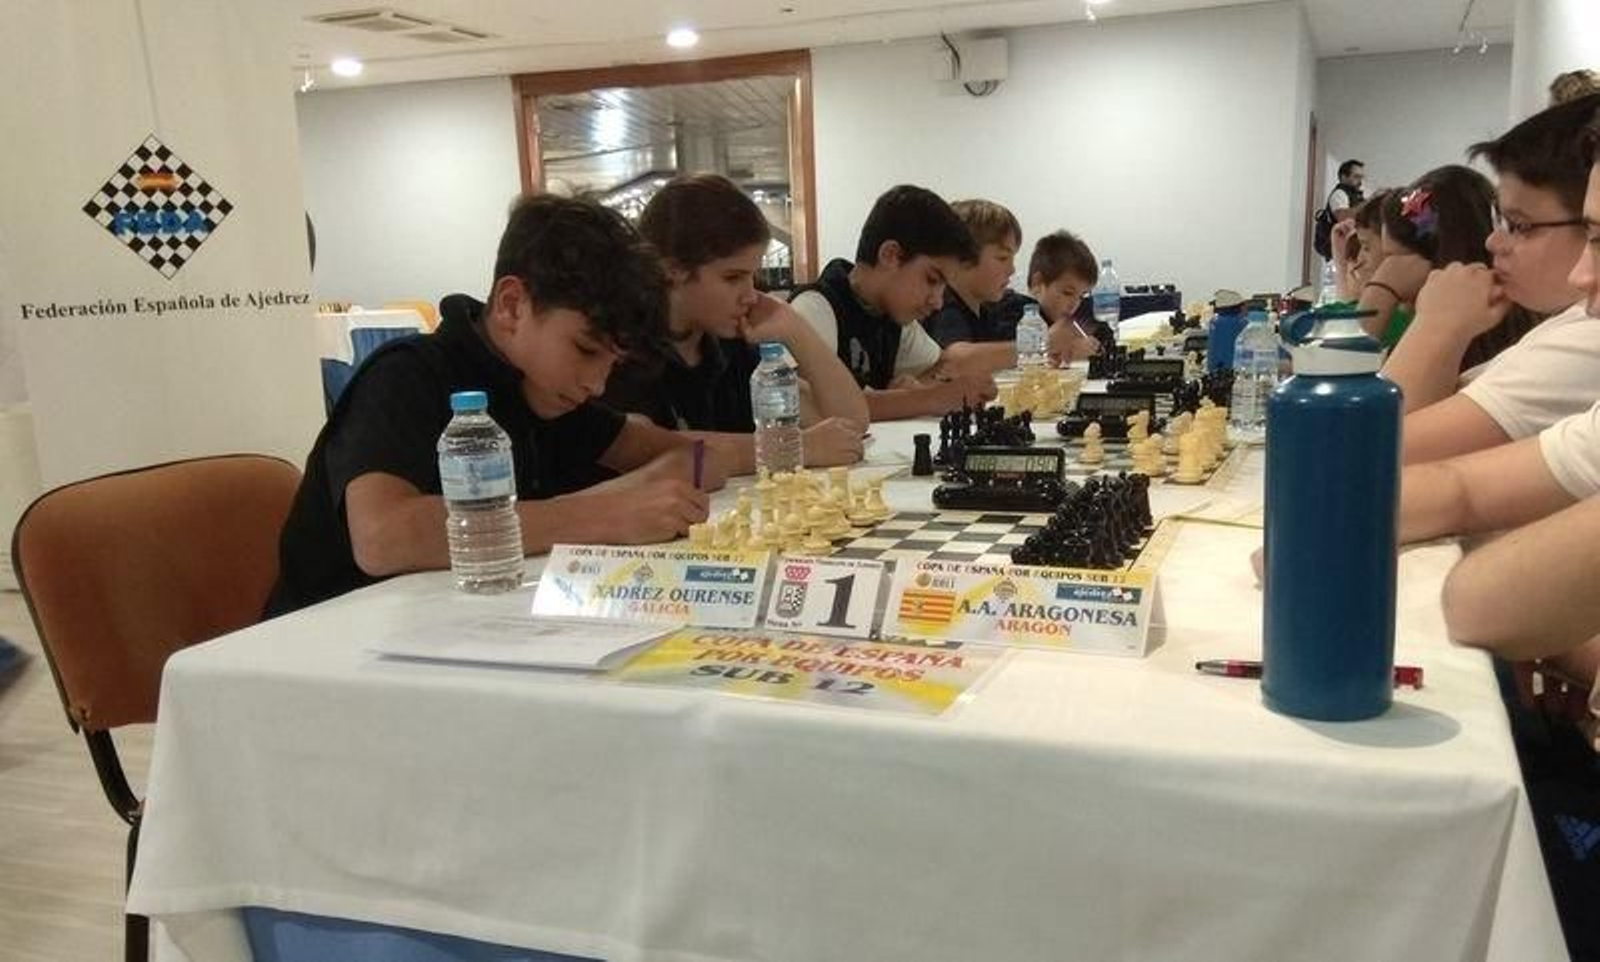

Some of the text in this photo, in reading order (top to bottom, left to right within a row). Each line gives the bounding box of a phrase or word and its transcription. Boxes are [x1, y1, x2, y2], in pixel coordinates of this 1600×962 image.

[113, 211, 209, 235] FEDA
[20, 290, 310, 320] Federación Española de Ajedrez
[917, 561, 943, 571] COPA
[947, 563, 961, 572] DE
[1008, 567, 1030, 577] POR
[1033, 570, 1082, 581] EQUIPOS
[1086, 573, 1108, 583] SUB
[593, 584, 755, 606] XADREZ OURENSE
[816, 573, 858, 631] 1
[629, 602, 691, 615] GALICIA
[956, 598, 1138, 627] A.A. ARAGONESA
[691, 633, 774, 651] COPA
[785, 638, 824, 655] DE
[693, 648, 926, 683] POR EQUIPOS
[690, 665, 876, 697] SUB 12
